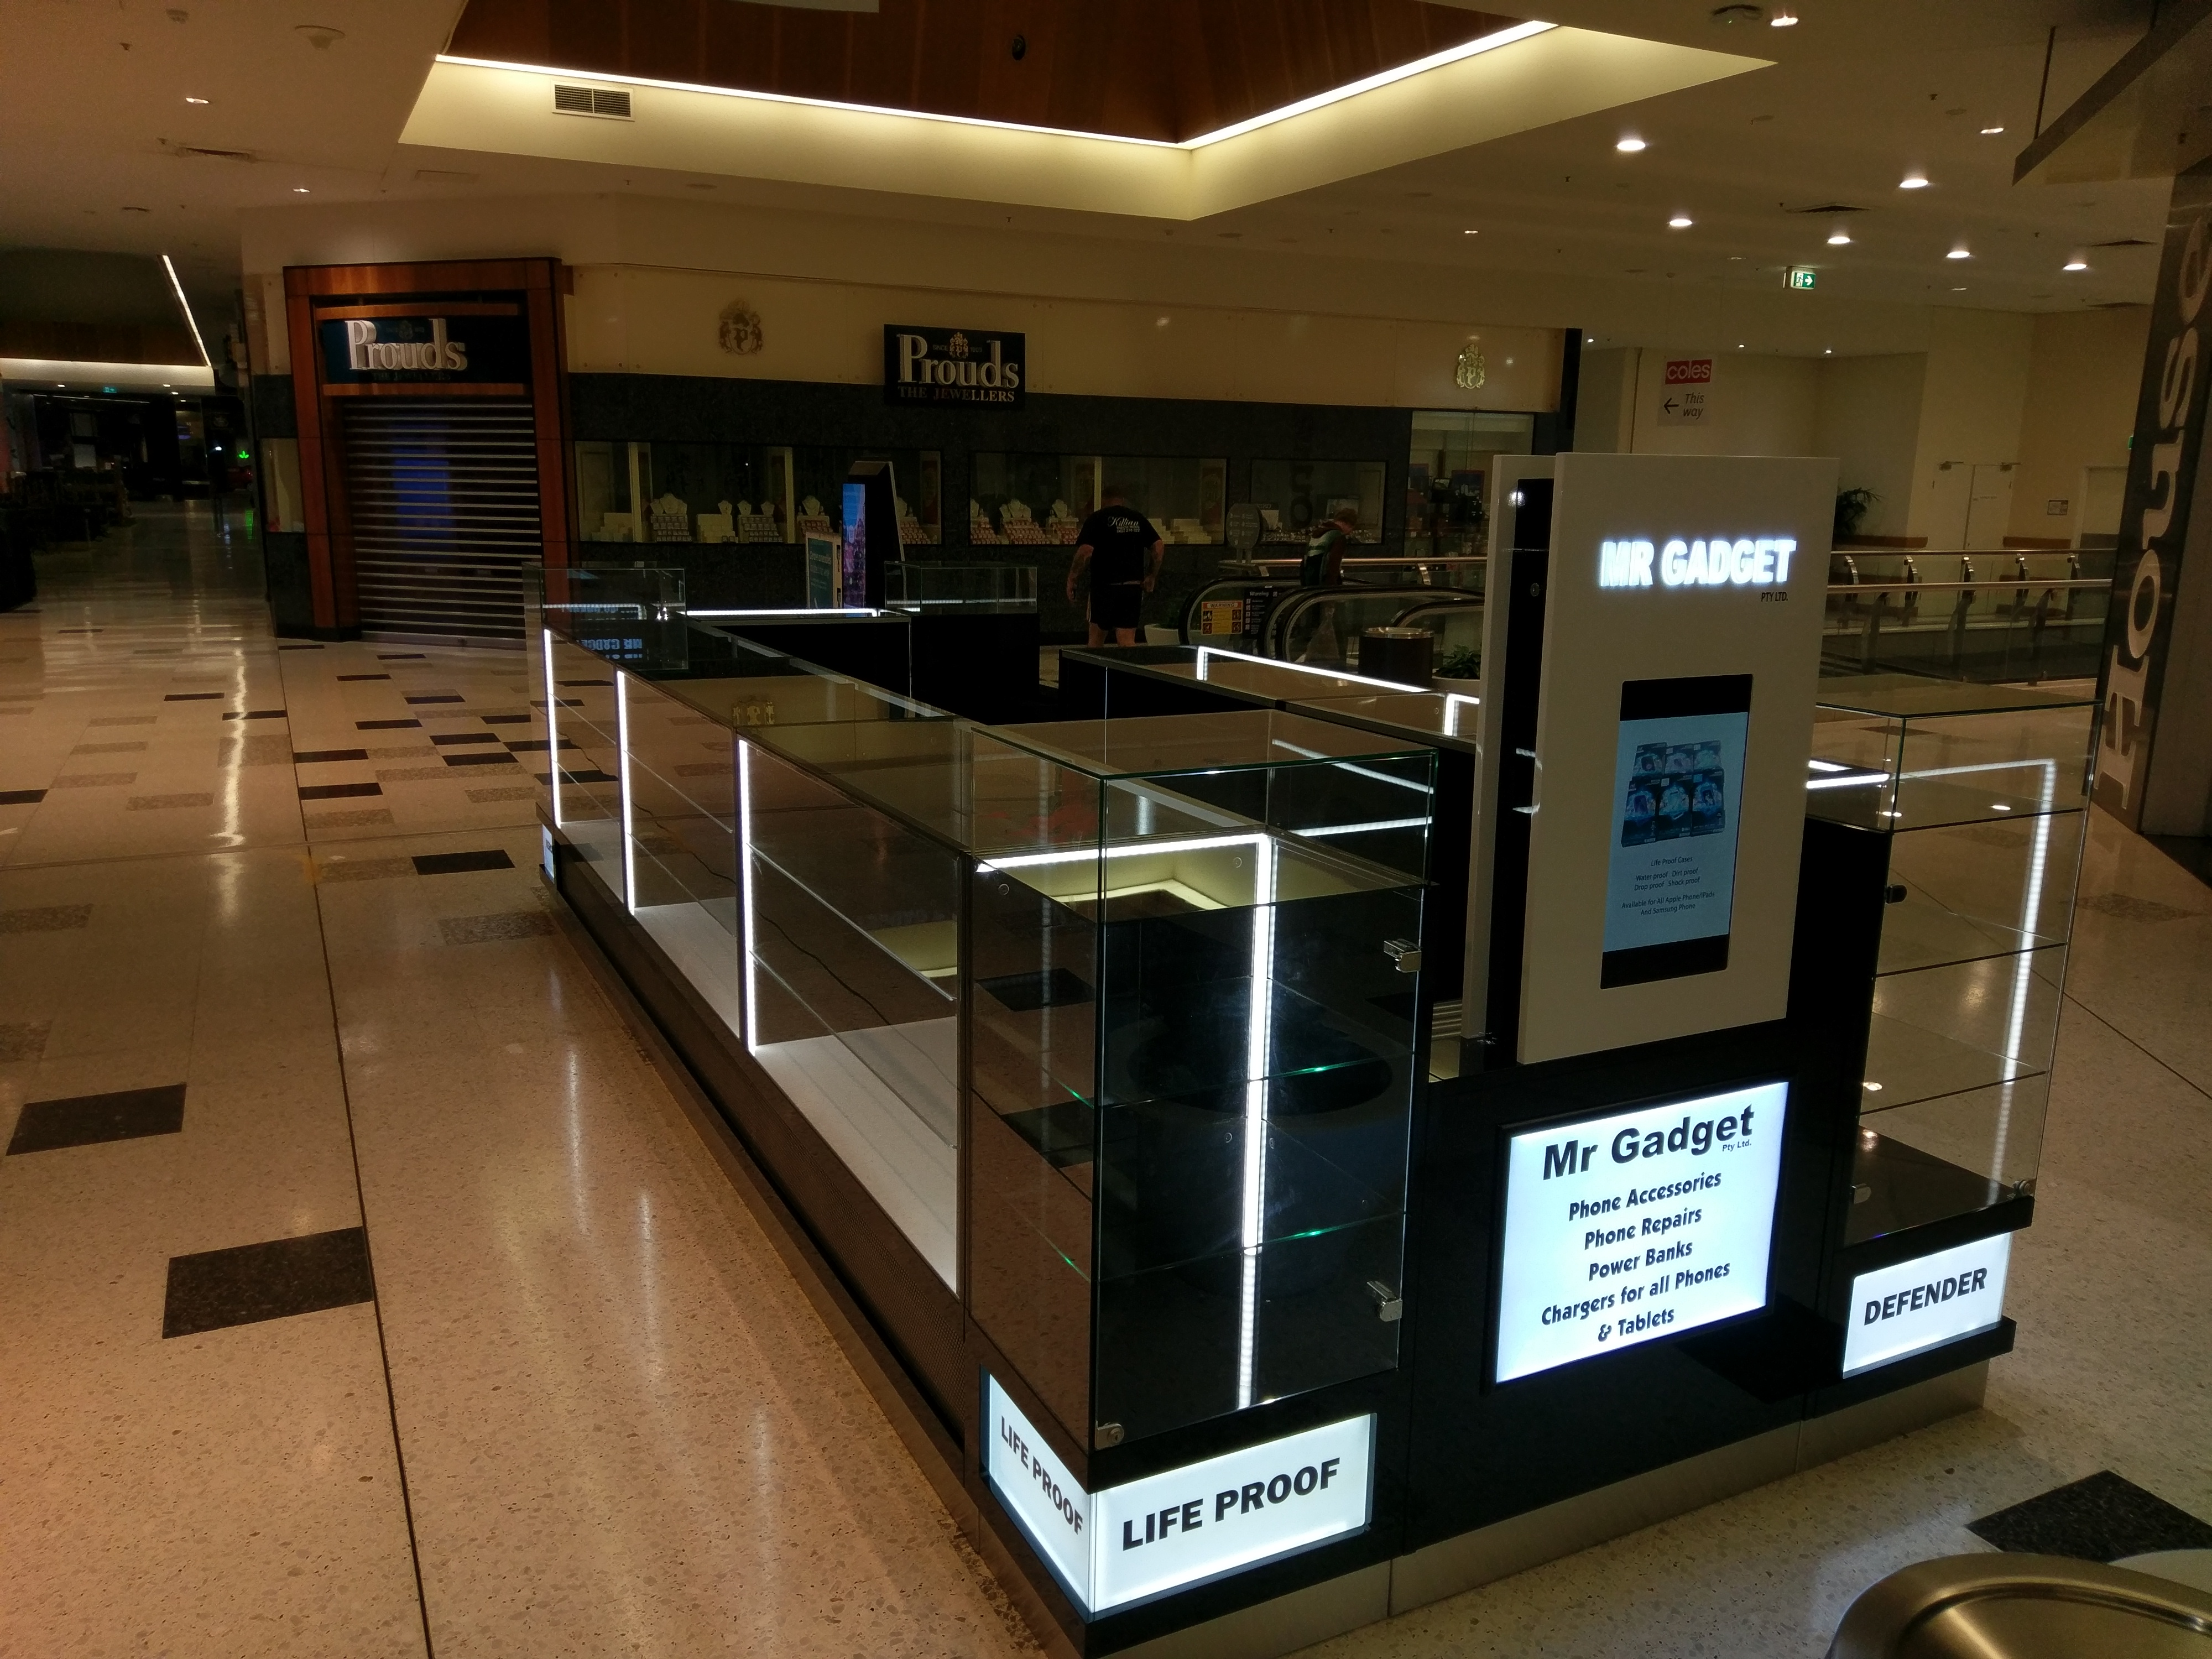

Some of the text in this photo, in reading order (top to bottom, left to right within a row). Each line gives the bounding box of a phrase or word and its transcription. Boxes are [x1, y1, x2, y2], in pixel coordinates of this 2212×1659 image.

[345, 318, 468, 371] Prouds
[896, 334, 1019, 389] Prouds
[1667, 361, 1710, 380] coles
[898, 386, 1015, 402] THE JEWELLERS
[1686, 392, 1704, 404] This
[1683, 408, 1703, 420] way
[1600, 540, 1797, 587] MR GADGET
[1761, 592, 1788, 602] PTY LTD.
[1653, 872, 1668, 880] proof
[1683, 867, 1699, 876] proof
[1662, 857, 1677, 865] Proof
[1649, 881, 1665, 889] proof
[1686, 877, 1701, 885] proof
[1665, 895, 1681, 904] Apple
[1653, 906, 1677, 914] Samsung
[1543, 1104, 1755, 1180] Mr Gadget
[1722, 1140, 1752, 1152] Pty Ltd.
[1569, 1171, 1722, 1222] Phone Accessories
[1584, 1207, 1702, 1250] Phone Repairs
[1589, 1240, 1693, 1281] Power Banks
[1541, 1262, 1730, 1326] Chargers for all Phones
[1864, 1267, 1987, 1326] DEFENDER
[1598, 1308, 1674, 1342] & Tablets
[1001, 1415, 1083, 1535] LIFE PROOF
[1123, 1457, 1340, 1551] LIFE PROOF
